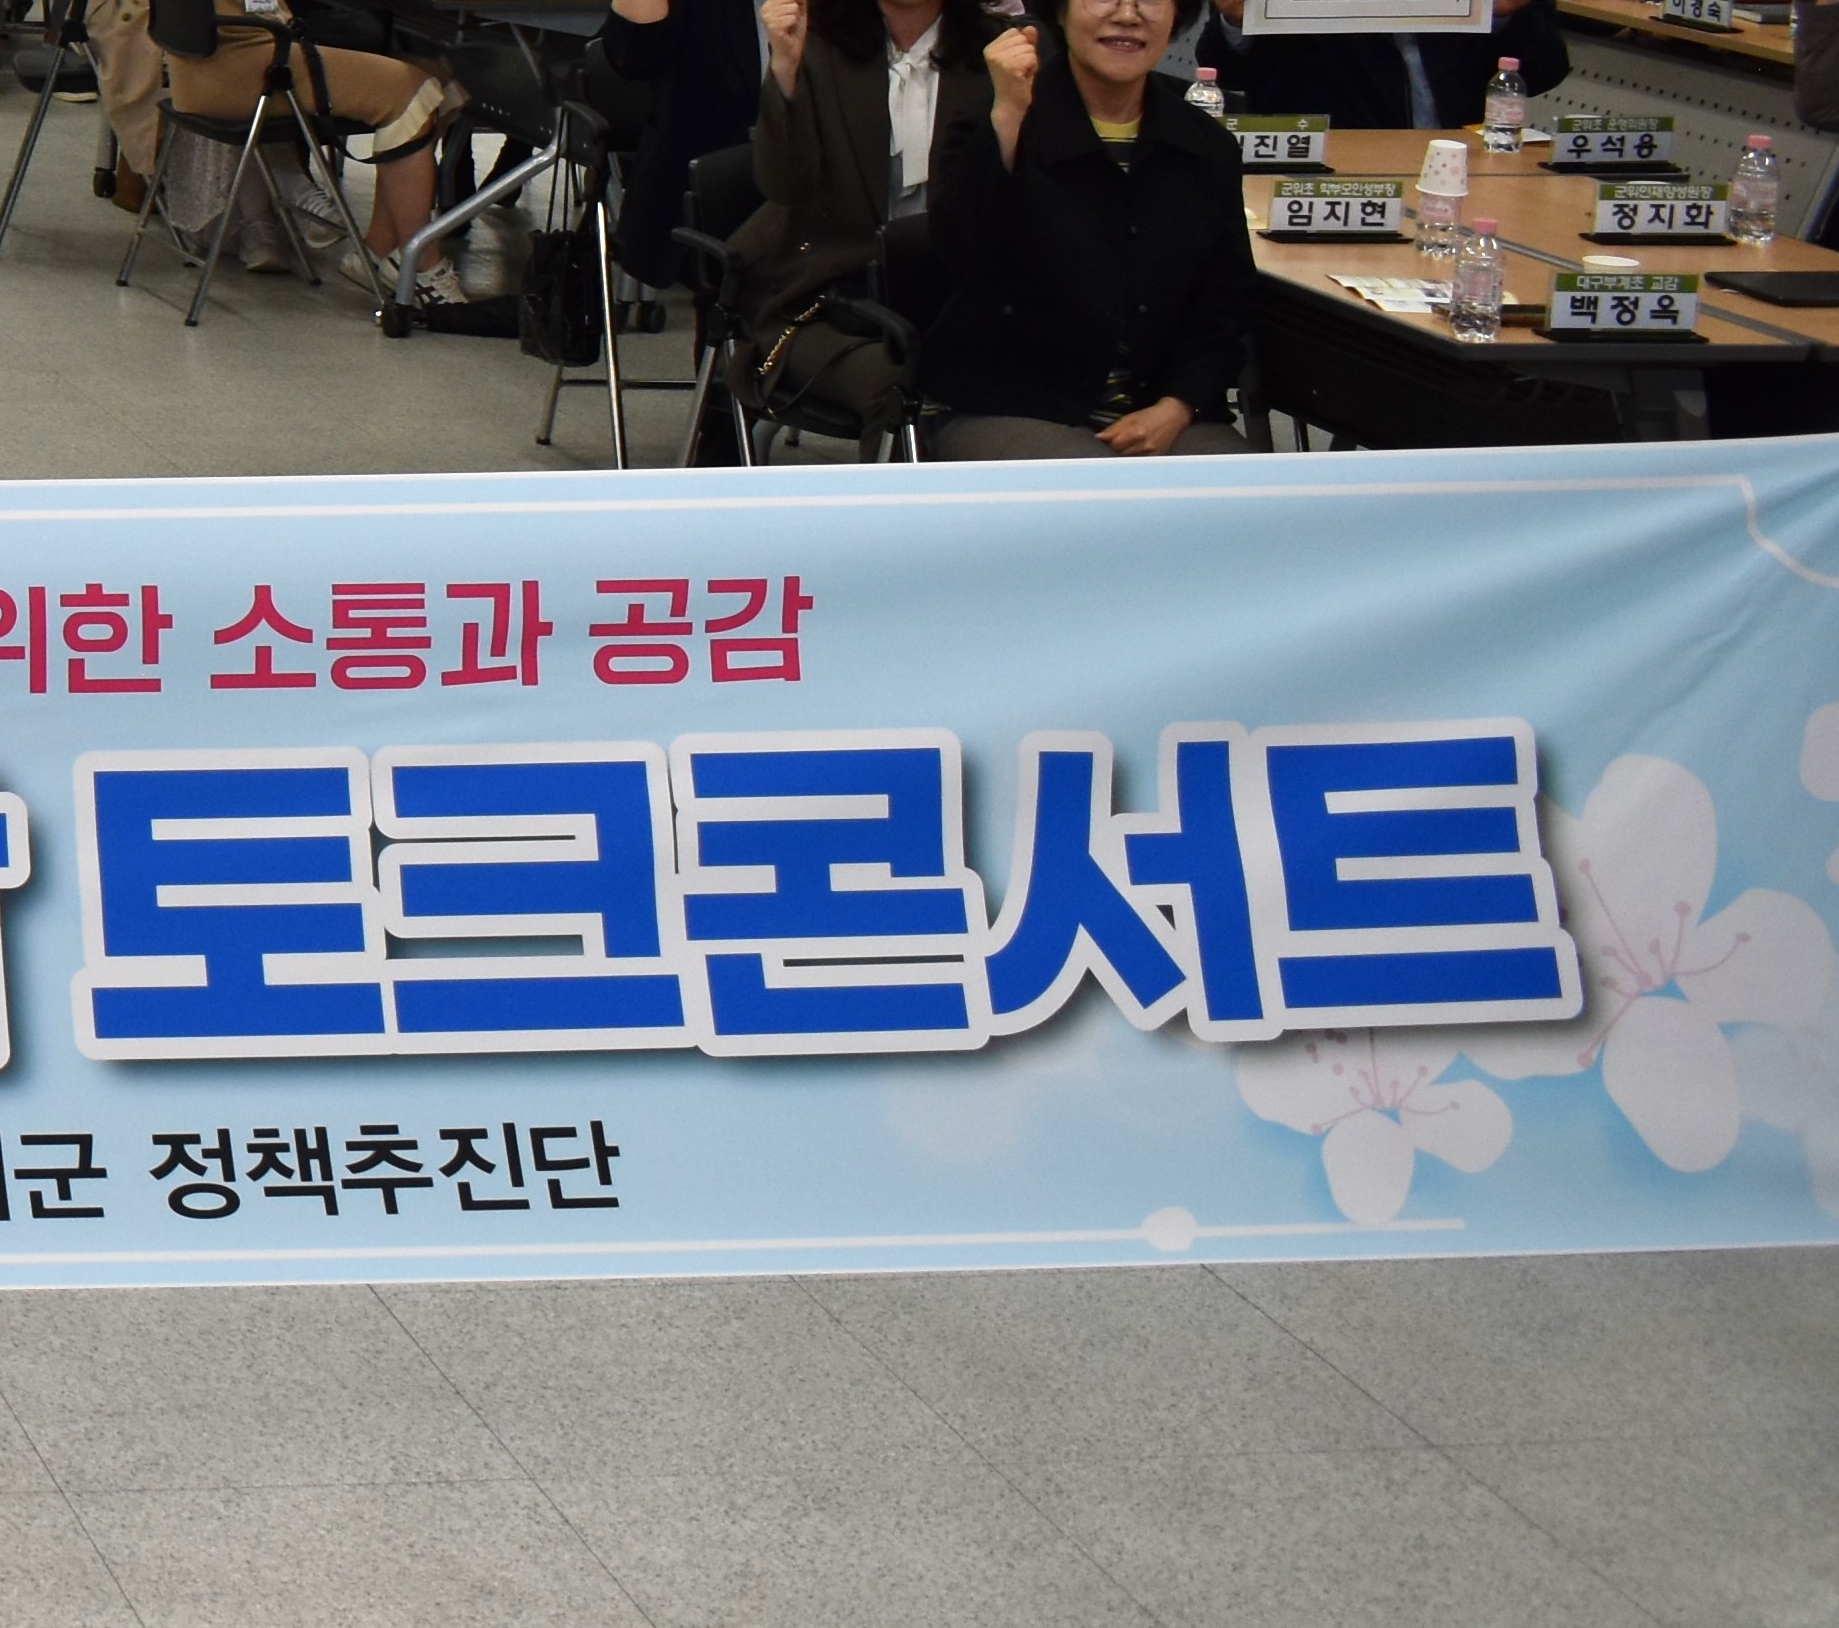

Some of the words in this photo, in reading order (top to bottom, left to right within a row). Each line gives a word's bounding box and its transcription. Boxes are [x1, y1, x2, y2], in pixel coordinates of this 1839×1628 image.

[1287, 199, 1386, 227] 임지현
[1612, 203, 1714, 230] 정지화
[1650, 276, 1679, 291] 교감
[1570, 295, 1679, 325] 백정옥
[211, 580, 553, 690] 소통과
[590, 577, 815, 684] 공감
[87, 730, 1567, 1044] 토크콘서트
[149, 1119, 621, 1220] 정책추진단
